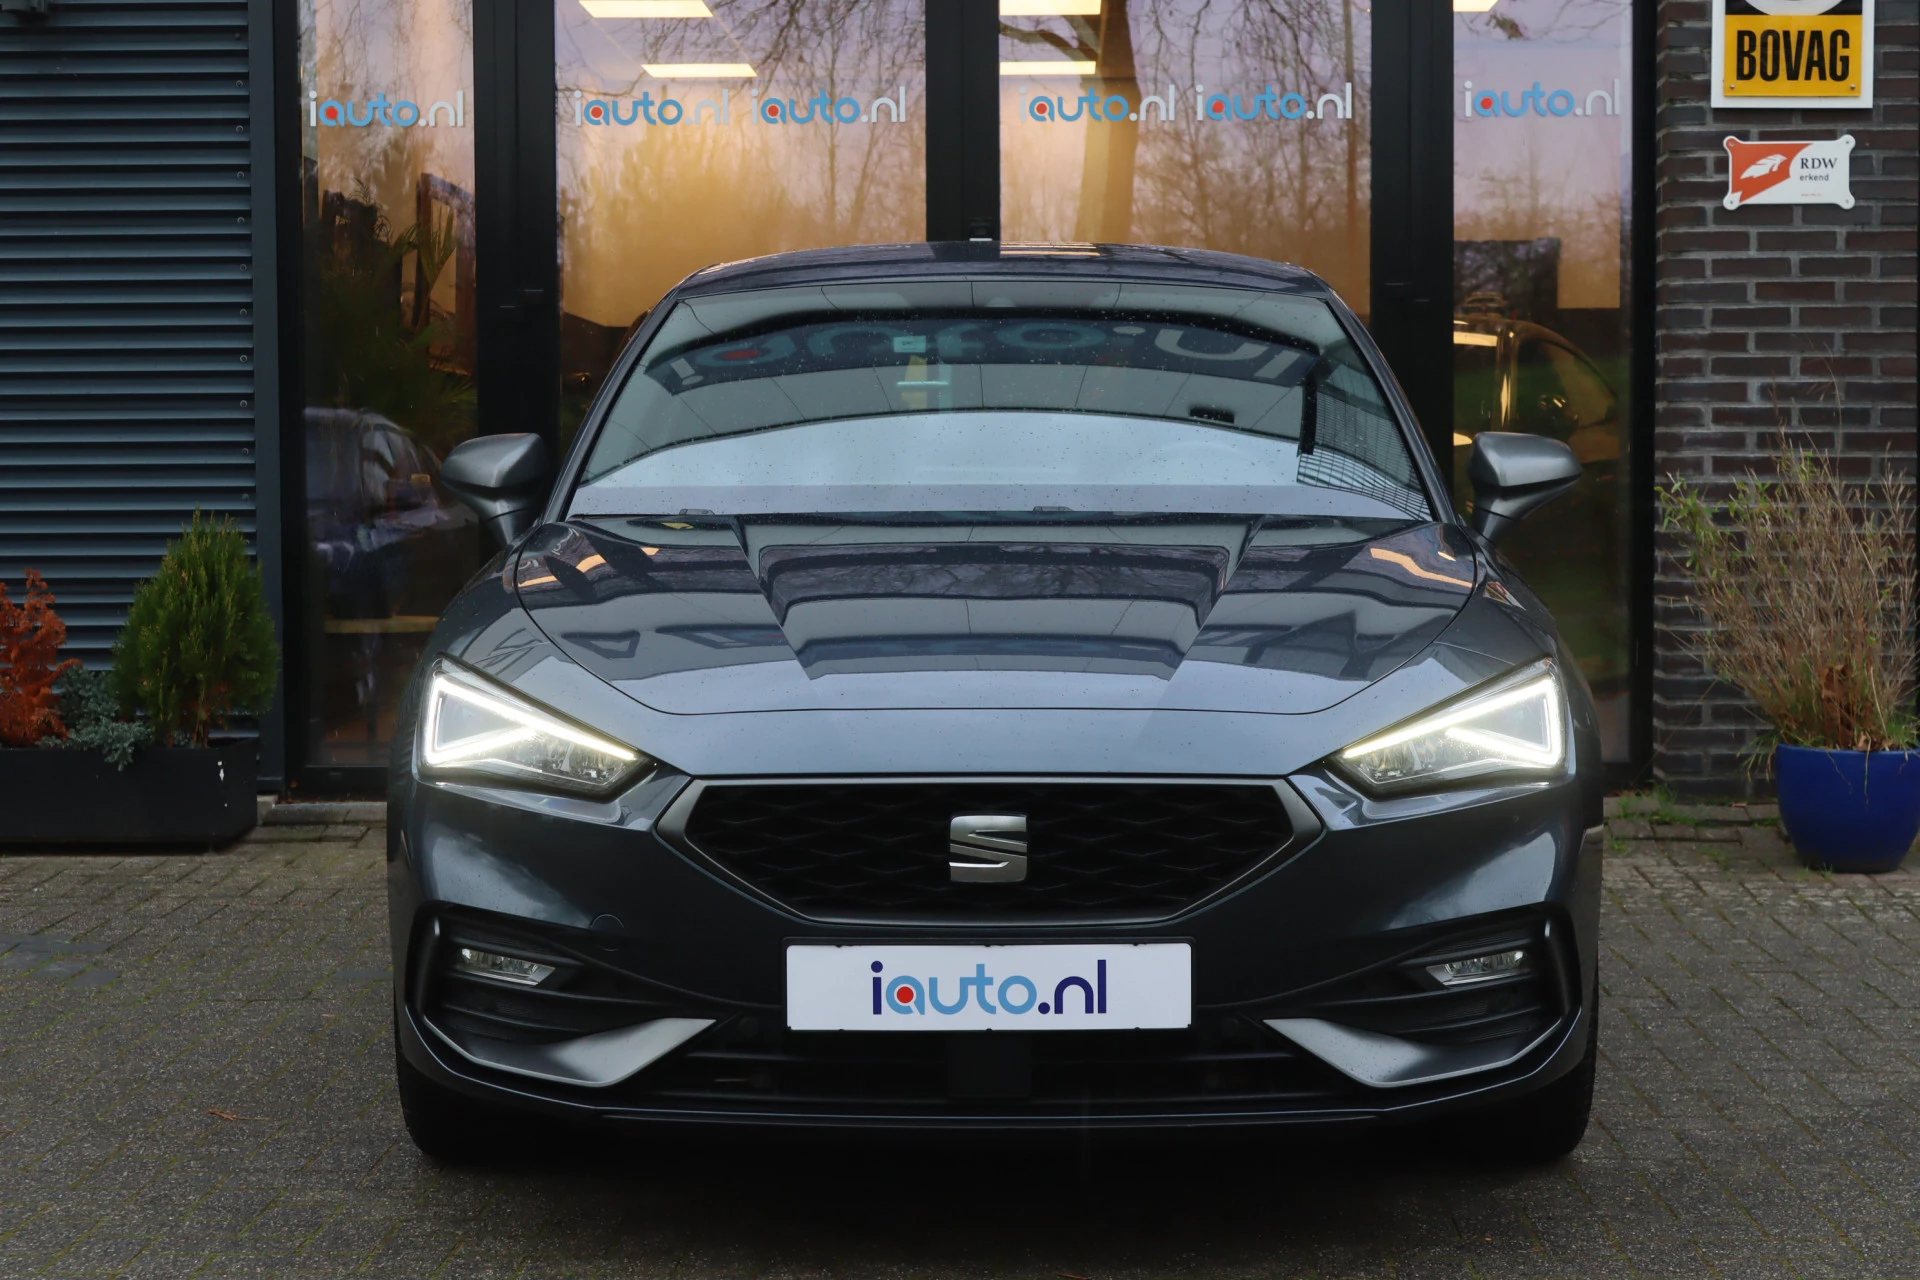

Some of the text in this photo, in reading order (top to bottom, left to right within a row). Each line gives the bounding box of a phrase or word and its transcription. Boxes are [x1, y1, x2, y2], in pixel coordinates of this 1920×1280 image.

[1736, 29, 1850, 82] BOVAG
[309, 90, 465, 127] iauto.nl
[574, 88, 730, 127] iauto.nl
[752, 86, 908, 125] iauto.nl
[1019, 84, 1175, 122] iauto.nl
[1196, 82, 1353, 120] iauto.nl
[1463, 79, 1621, 117] iauto.nl
[1799, 172, 1830, 182] erkend
[1800, 157, 1838, 171] RDW
[870, 959, 1107, 1016] iauto.nl
